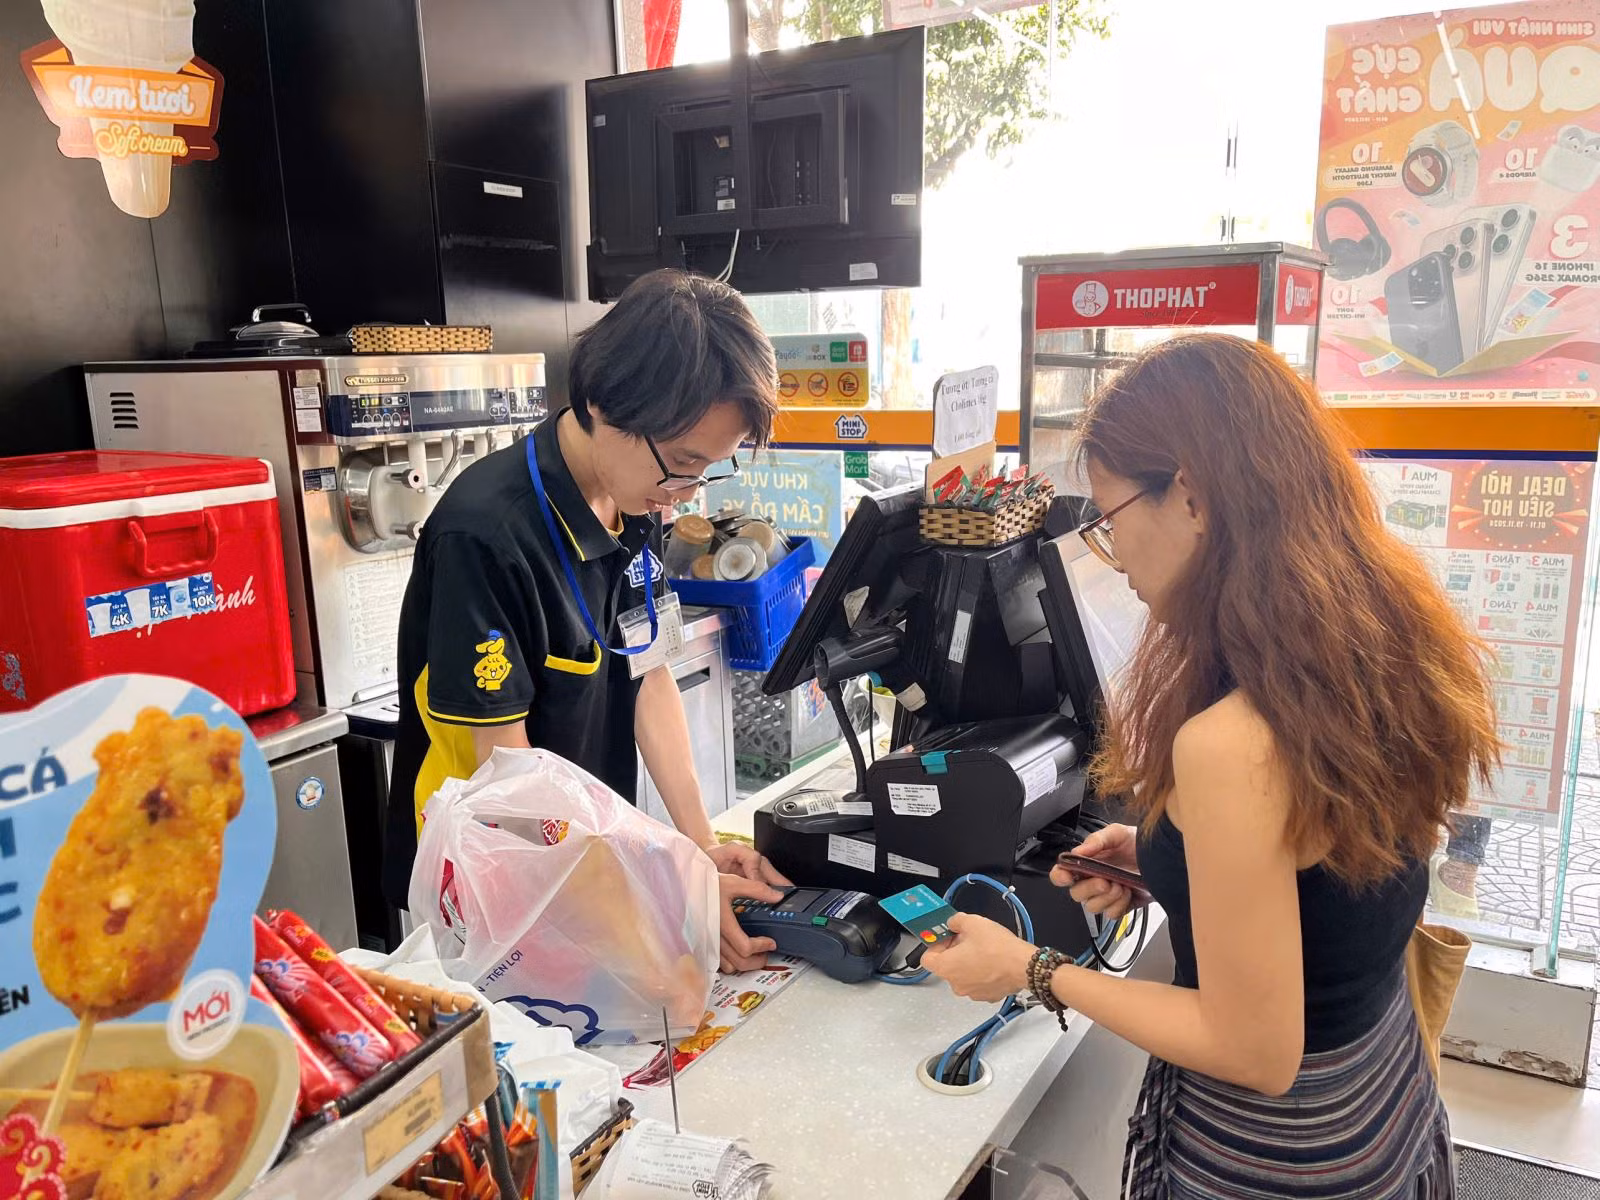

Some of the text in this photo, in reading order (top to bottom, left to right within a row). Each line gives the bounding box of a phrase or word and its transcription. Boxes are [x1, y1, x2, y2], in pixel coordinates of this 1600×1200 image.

[69, 75, 195, 115] Kem tươi
[1113, 285, 1208, 309] THOPHAT
[842, 420, 861, 428] MINI
[841, 428, 862, 436] STOP
[845, 455, 868, 465] Grab
[845, 465, 868, 474] Mart
[193, 593, 215, 609] 10K
[151, 604, 169, 618] 7K
[111, 613, 130, 627] 4K
[0, 748, 67, 801] CÁ
[486, 963, 509, 982] TIỆN
[505, 949, 524, 967] LỢI
[184, 990, 231, 1032] MỚI
